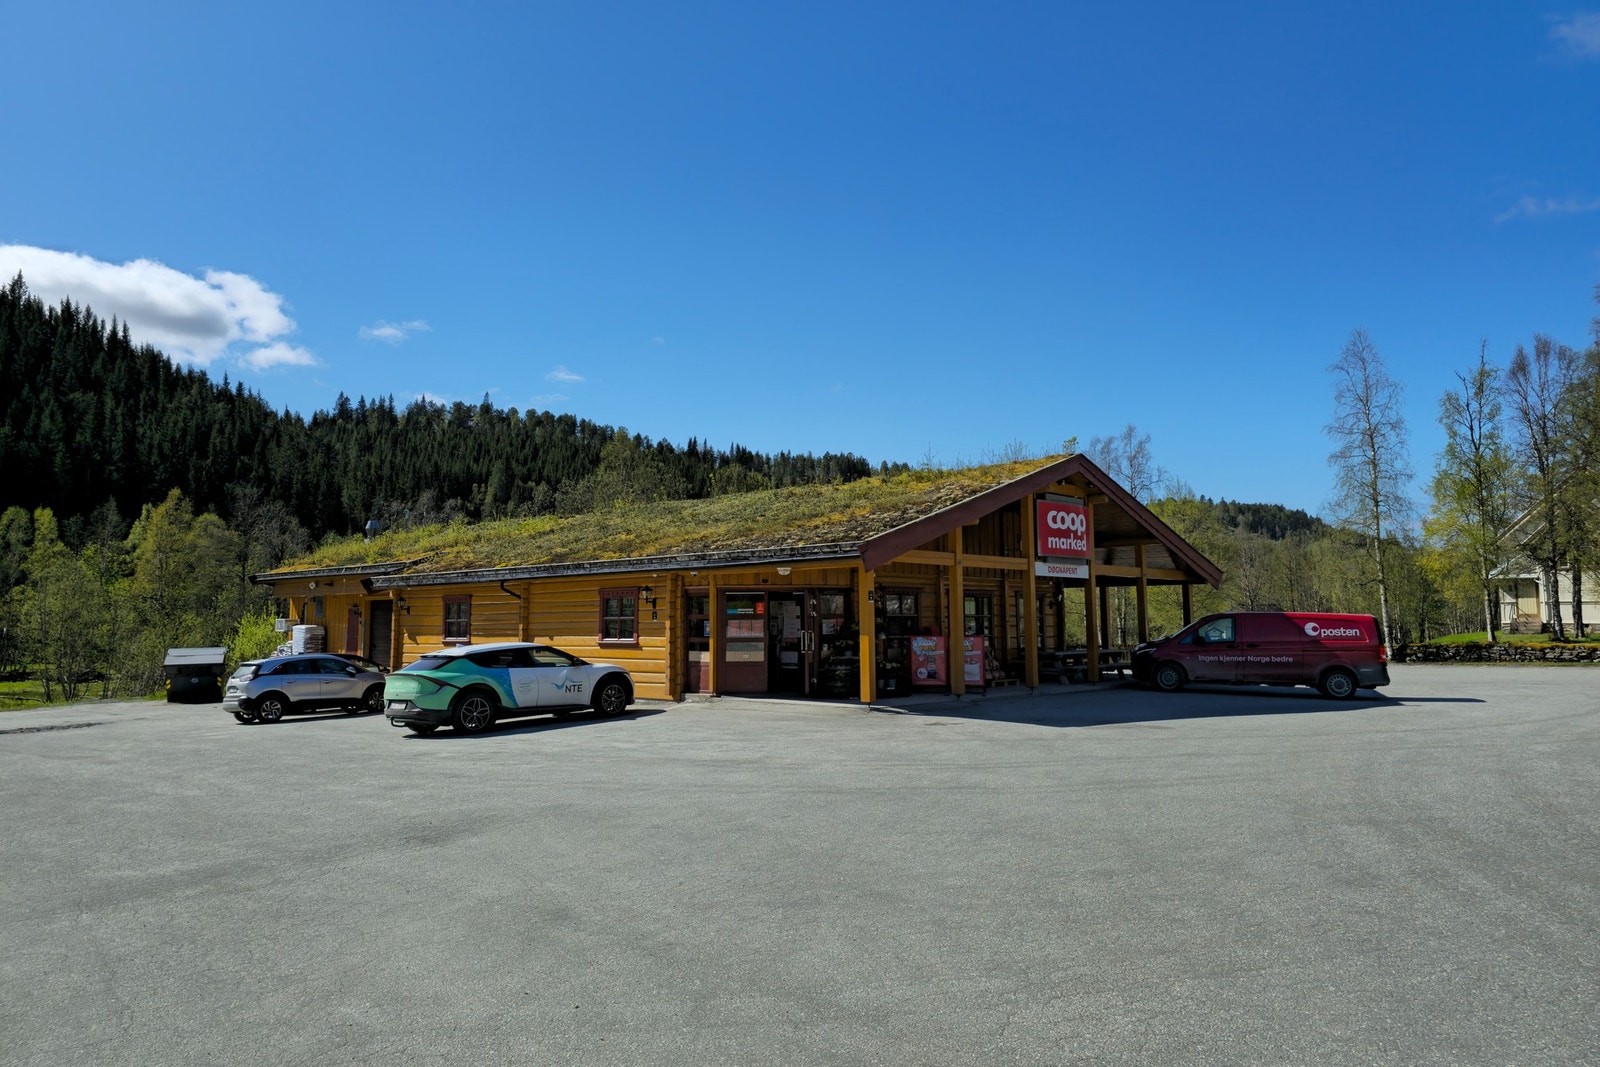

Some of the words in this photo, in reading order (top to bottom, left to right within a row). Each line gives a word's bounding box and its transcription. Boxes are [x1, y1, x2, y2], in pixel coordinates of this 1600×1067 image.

[1047, 510, 1086, 535] coop
[1048, 533, 1086, 551] marked
[1048, 565, 1078, 575] DØGNÅPENT
[1321, 626, 1360, 638] posten
[1198, 654, 1218, 664] Ingen
[1219, 654, 1246, 664] kjenner
[1247, 655, 1270, 664] Norge
[1271, 655, 1293, 663] bedre
[564, 683, 583, 693] NTE
